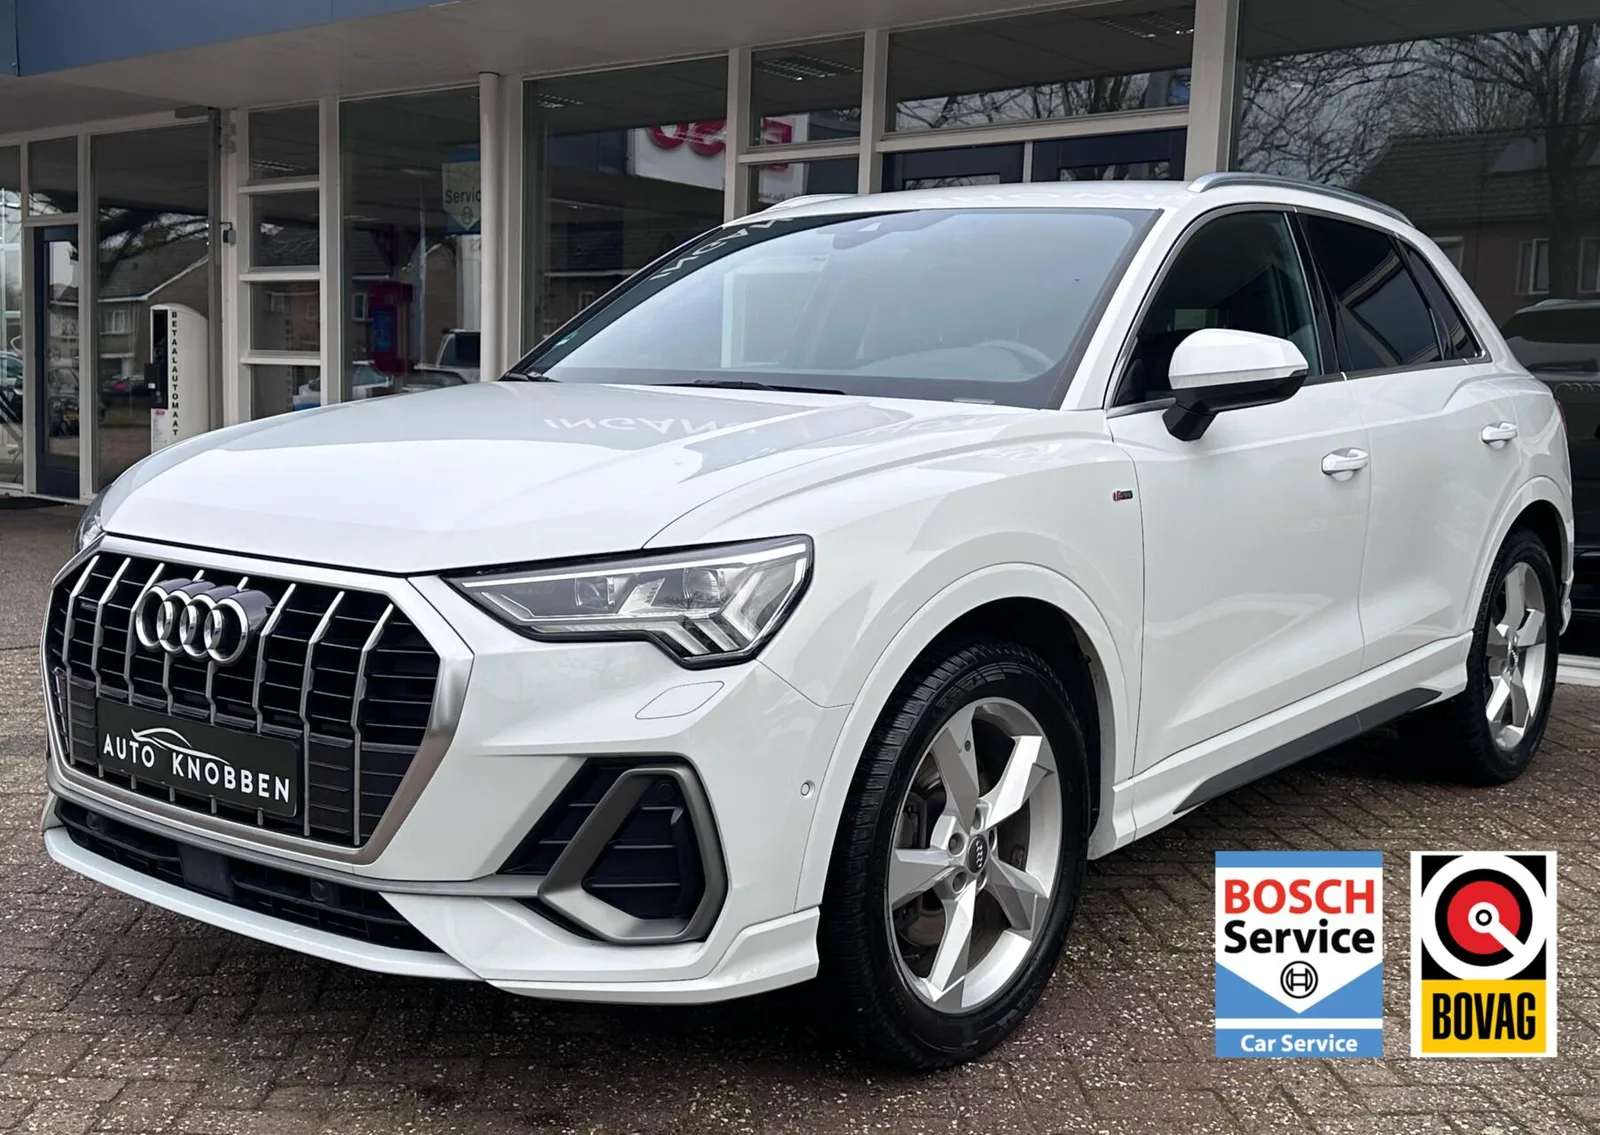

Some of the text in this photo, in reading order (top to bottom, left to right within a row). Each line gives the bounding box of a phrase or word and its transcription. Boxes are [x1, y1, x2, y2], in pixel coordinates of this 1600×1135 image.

[445, 187, 481, 204] Servic
[171, 311, 179, 436] BETAALAUTOMAAT
[103, 733, 290, 803] AUTO KNOBBEN
